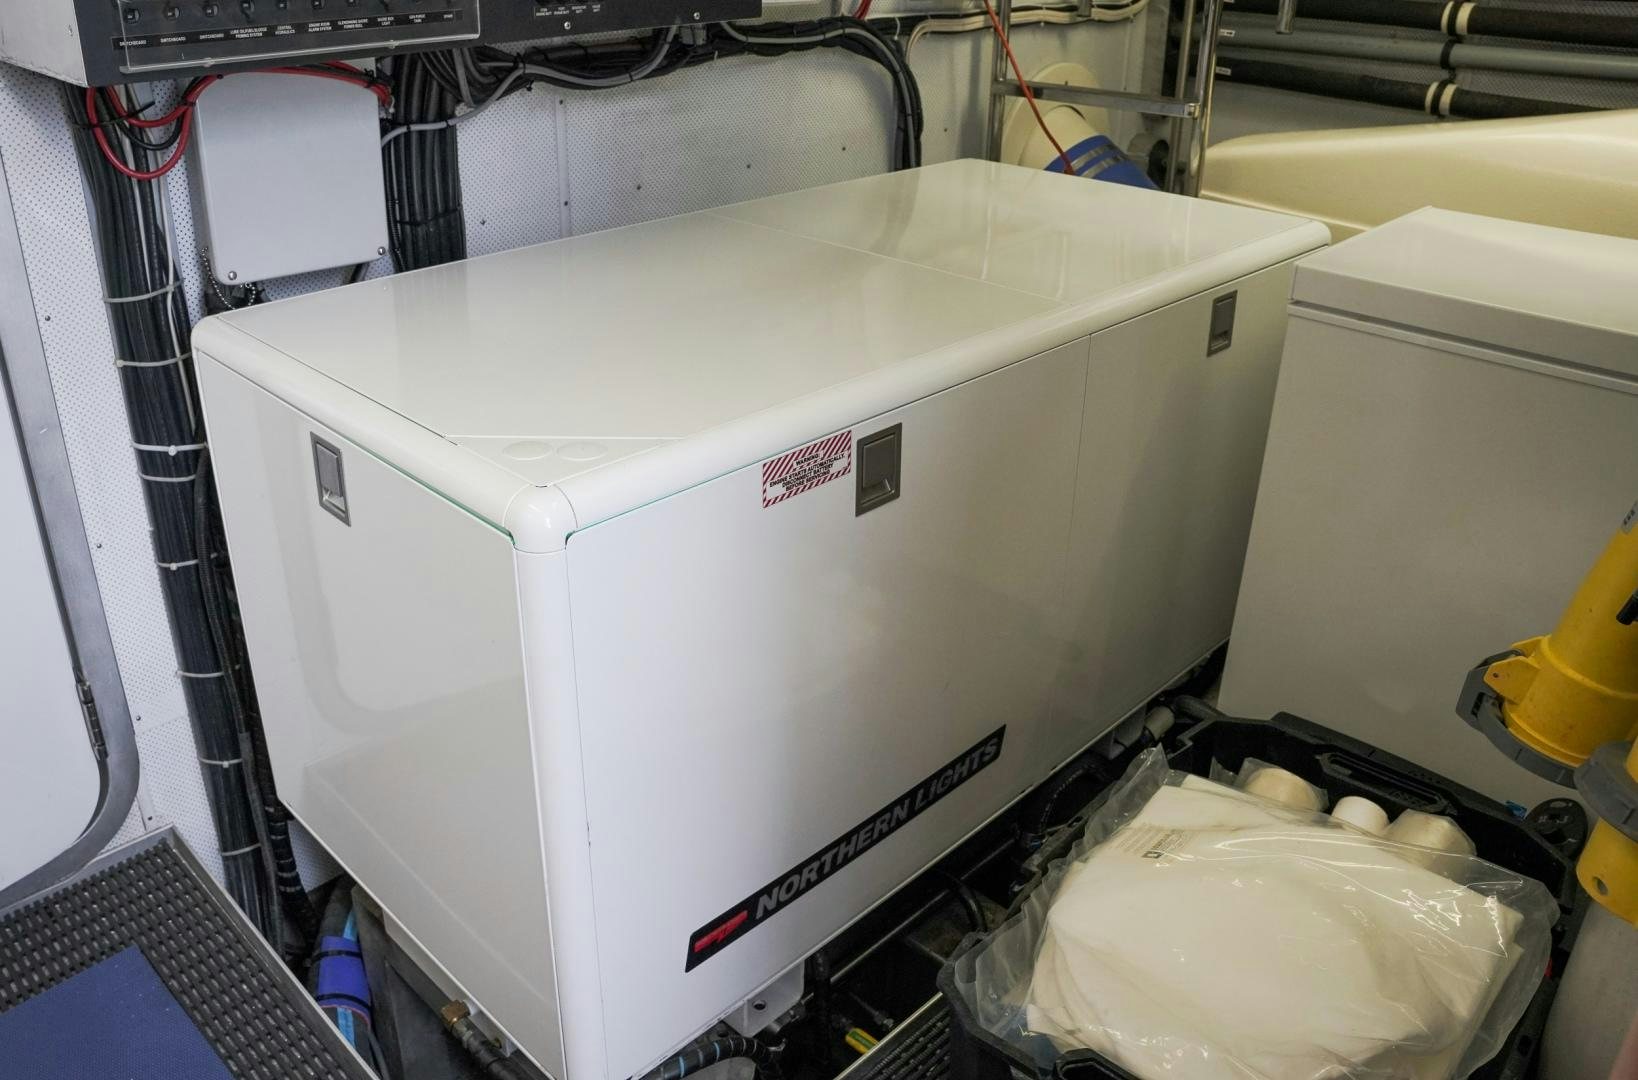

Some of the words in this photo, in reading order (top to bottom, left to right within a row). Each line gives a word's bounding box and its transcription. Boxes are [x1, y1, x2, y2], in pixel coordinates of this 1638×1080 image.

[769, 476, 788, 487] ENGINE
[788, 470, 807, 481] STARTS
[781, 471, 813, 488] DISCONNECT
[813, 463, 834, 475] BATTERY
[785, 479, 806, 491] BEFORE
[805, 469, 831, 484] SERVICING
[755, 803, 911, 920] NORTHERN
[913, 736, 999, 812] LIGHTS
